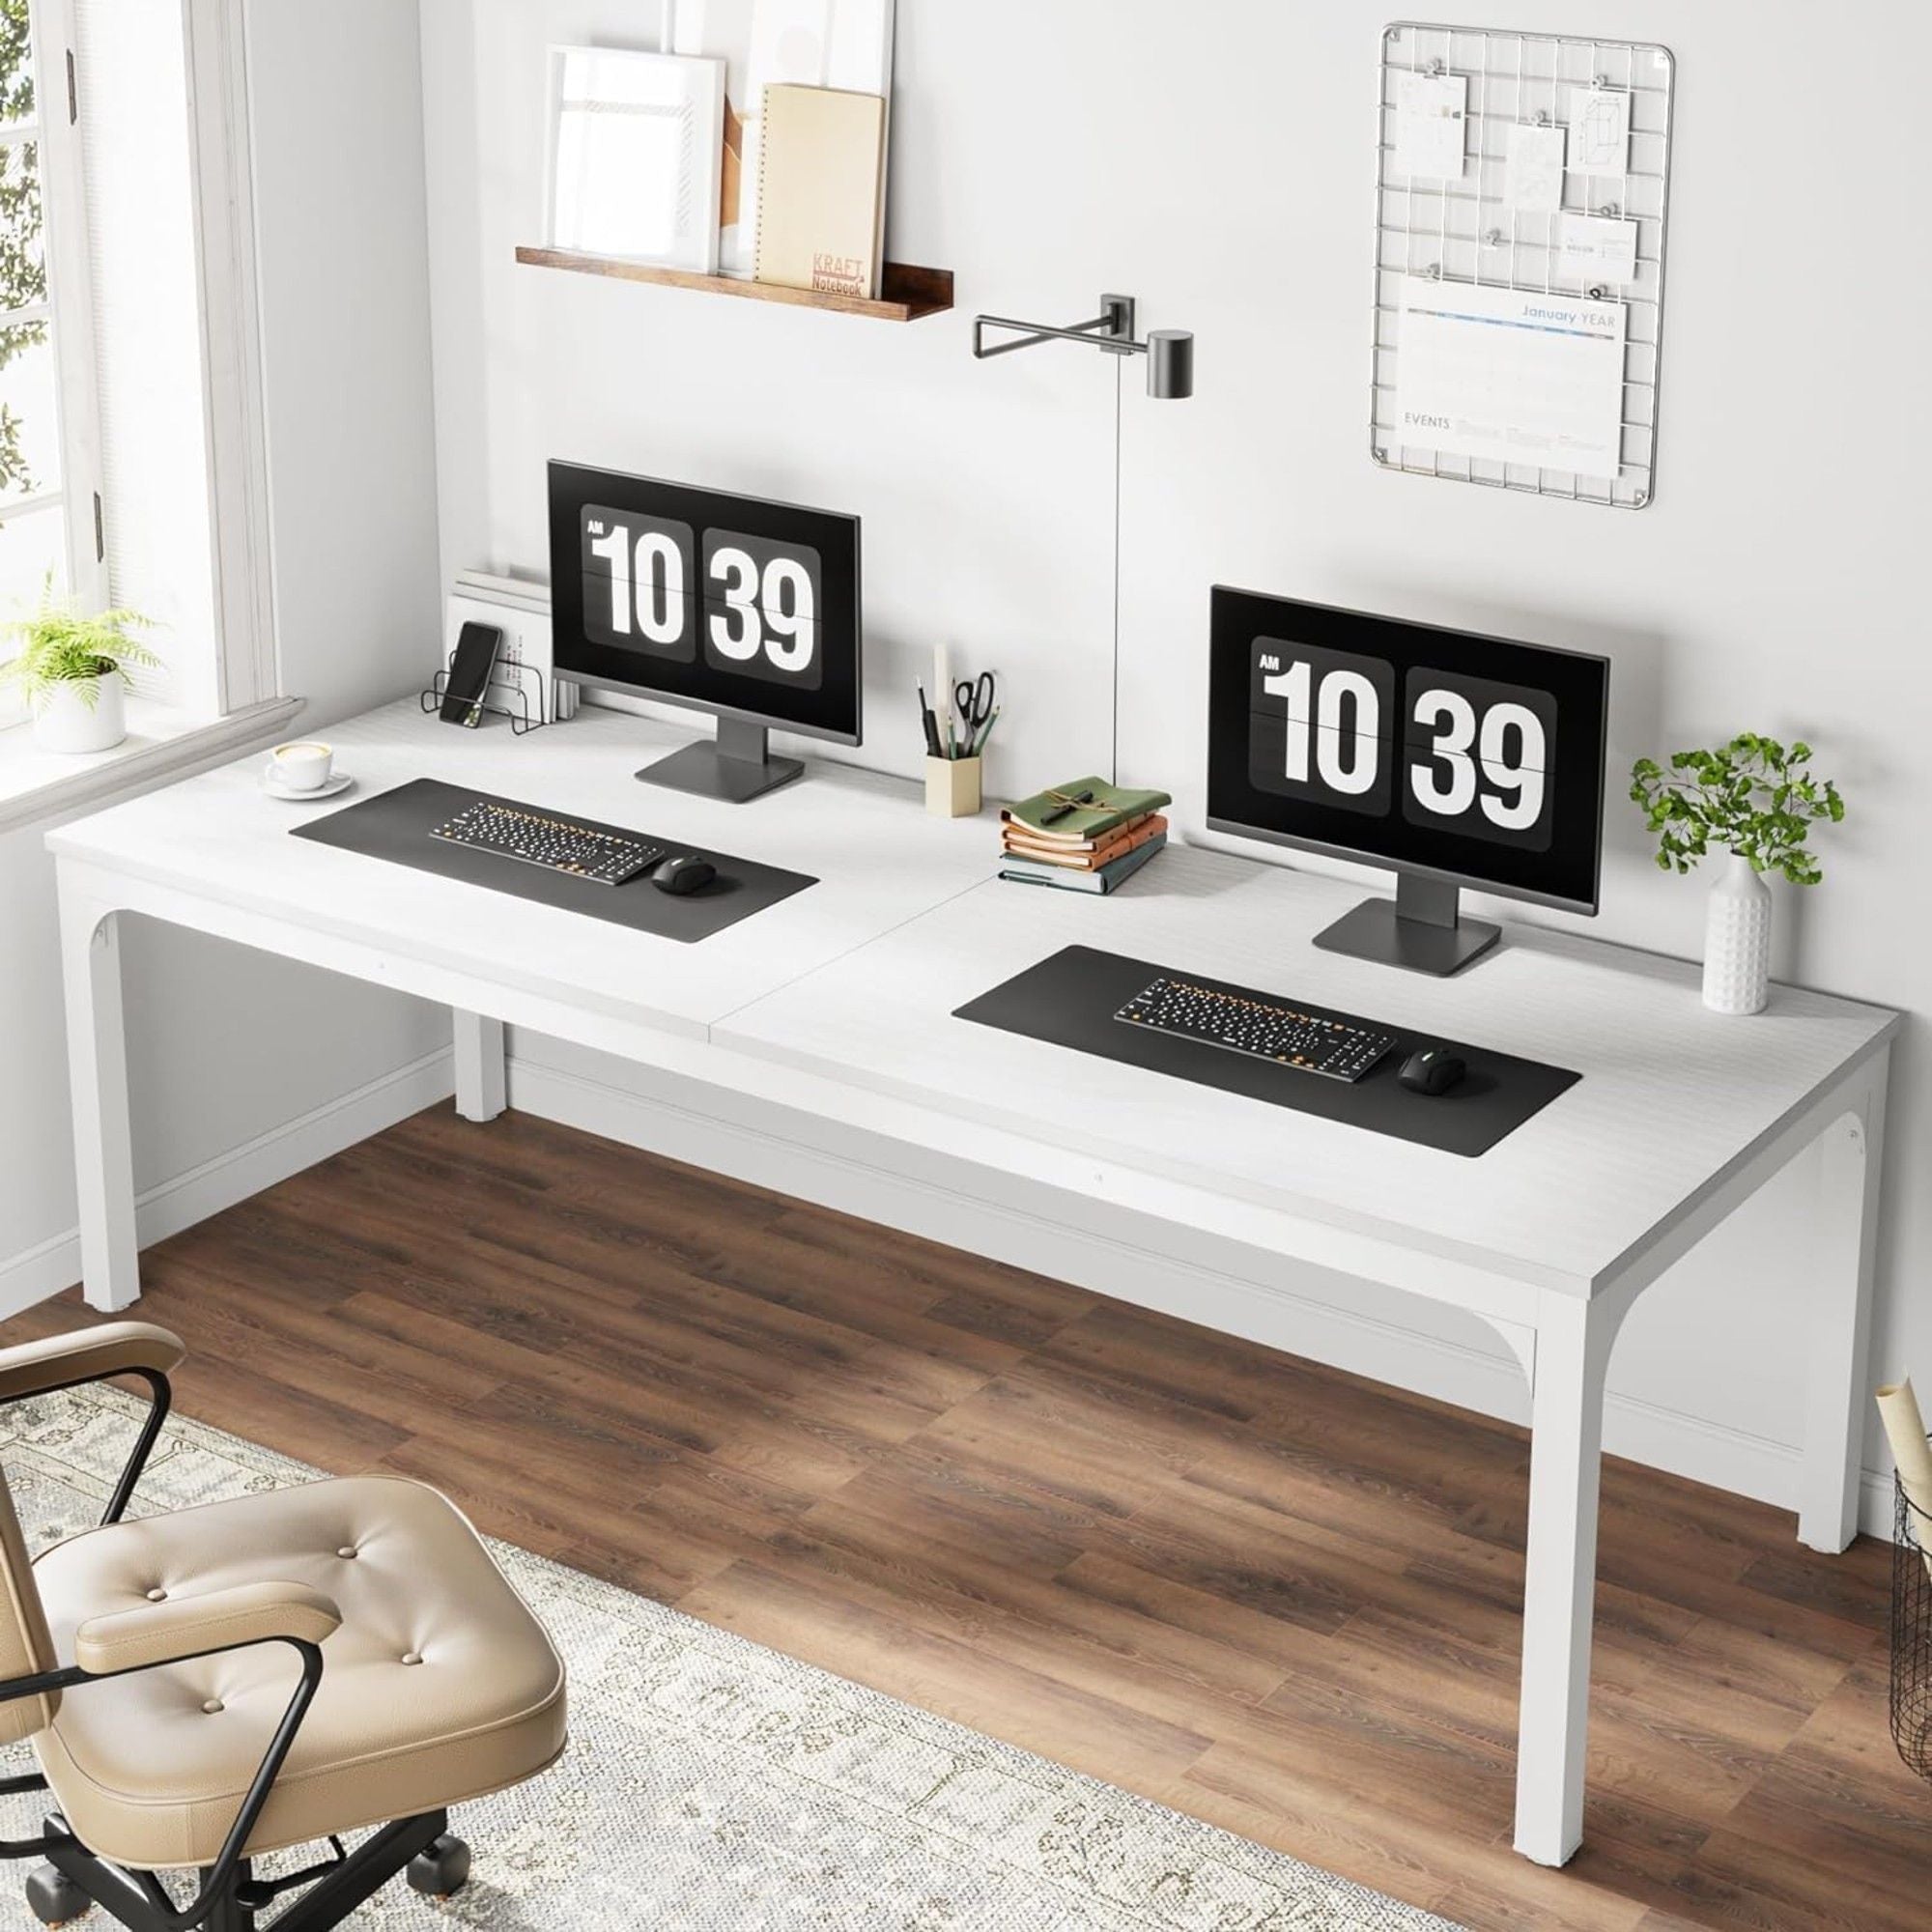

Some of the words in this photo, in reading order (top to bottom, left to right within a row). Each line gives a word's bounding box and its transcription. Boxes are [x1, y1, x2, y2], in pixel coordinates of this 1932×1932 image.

[813, 252, 864, 277] KRAFT
[812, 275, 862, 296] Notebook
[1521, 304, 1577, 323] January
[1581, 309, 1616, 327] YEAR
[1405, 412, 1450, 429] EVENTS
[587, 520, 604, 535] AM
[592, 525, 685, 645] 10
[709, 547, 814, 672] 39
[1260, 654, 1280, 671] AM
[1264, 661, 1379, 795] 10
[1410, 689, 1547, 831] 39
